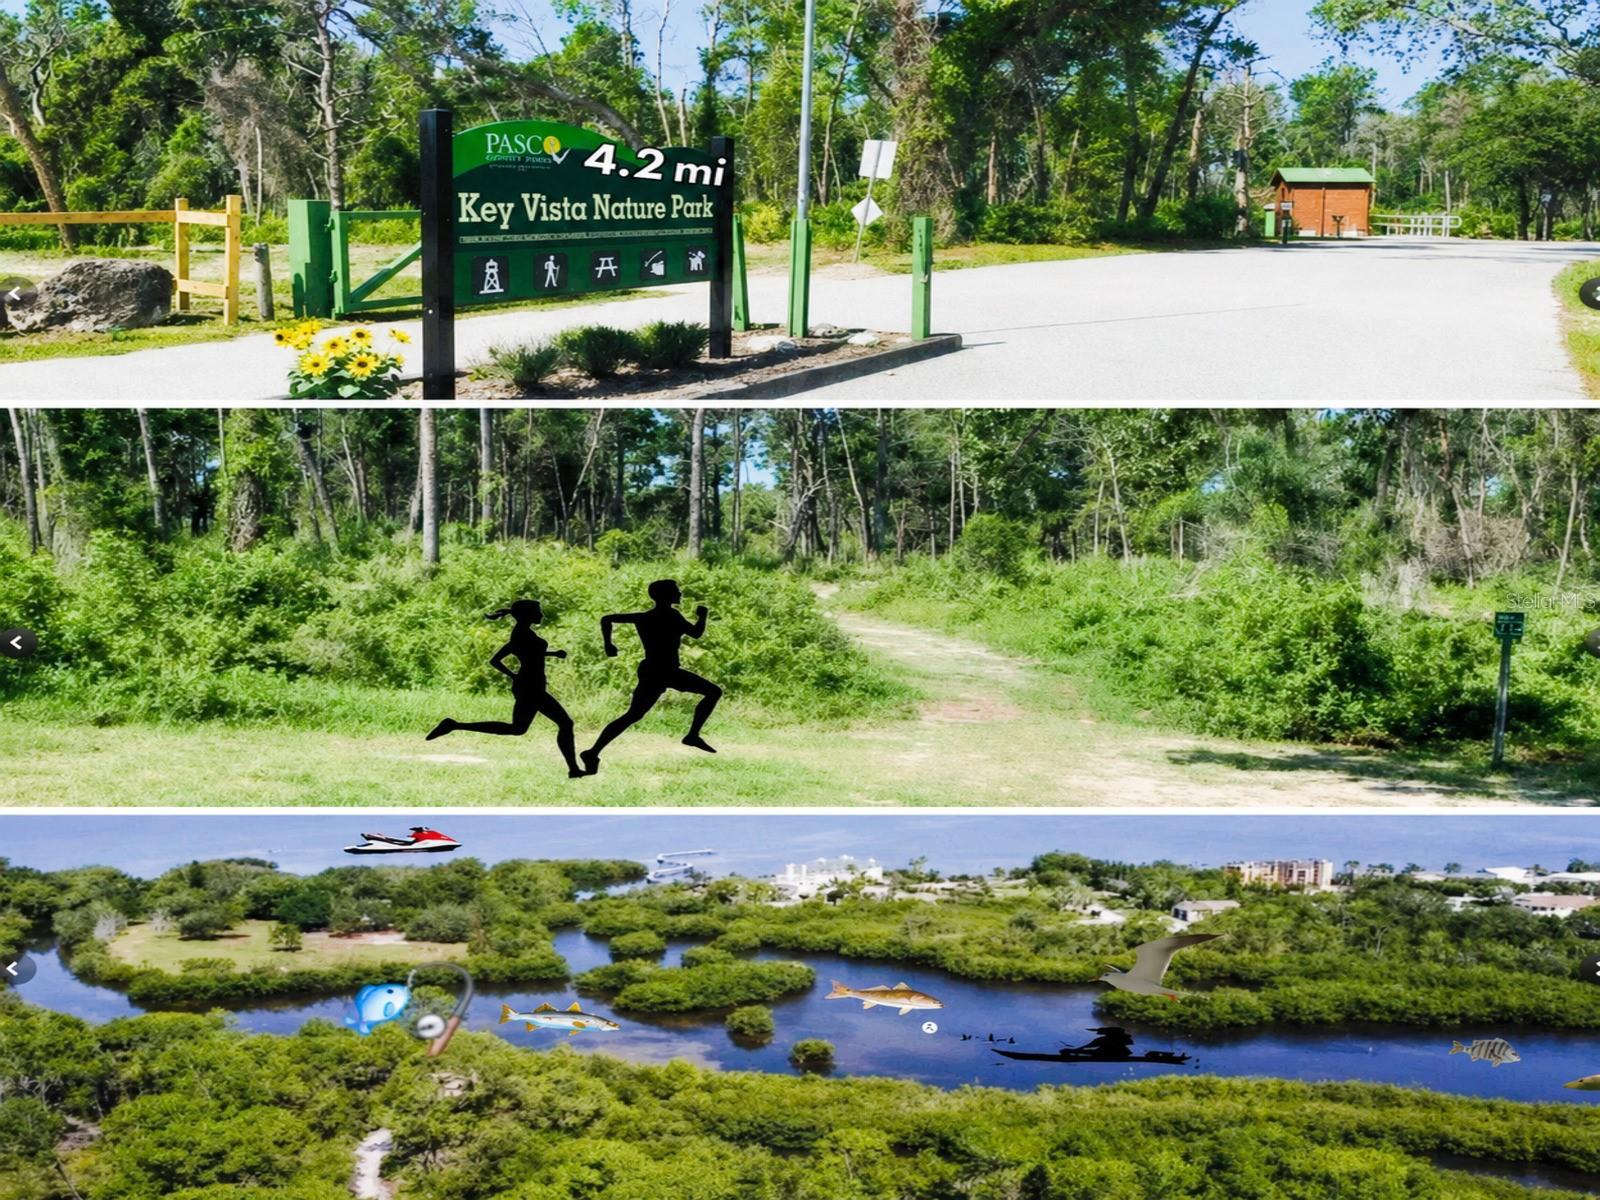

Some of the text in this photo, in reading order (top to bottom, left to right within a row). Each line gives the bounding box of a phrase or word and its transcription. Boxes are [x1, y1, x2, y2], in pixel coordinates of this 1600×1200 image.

[485, 133, 561, 155] PASCO
[458, 192, 714, 230] Key Vista Nature Park
